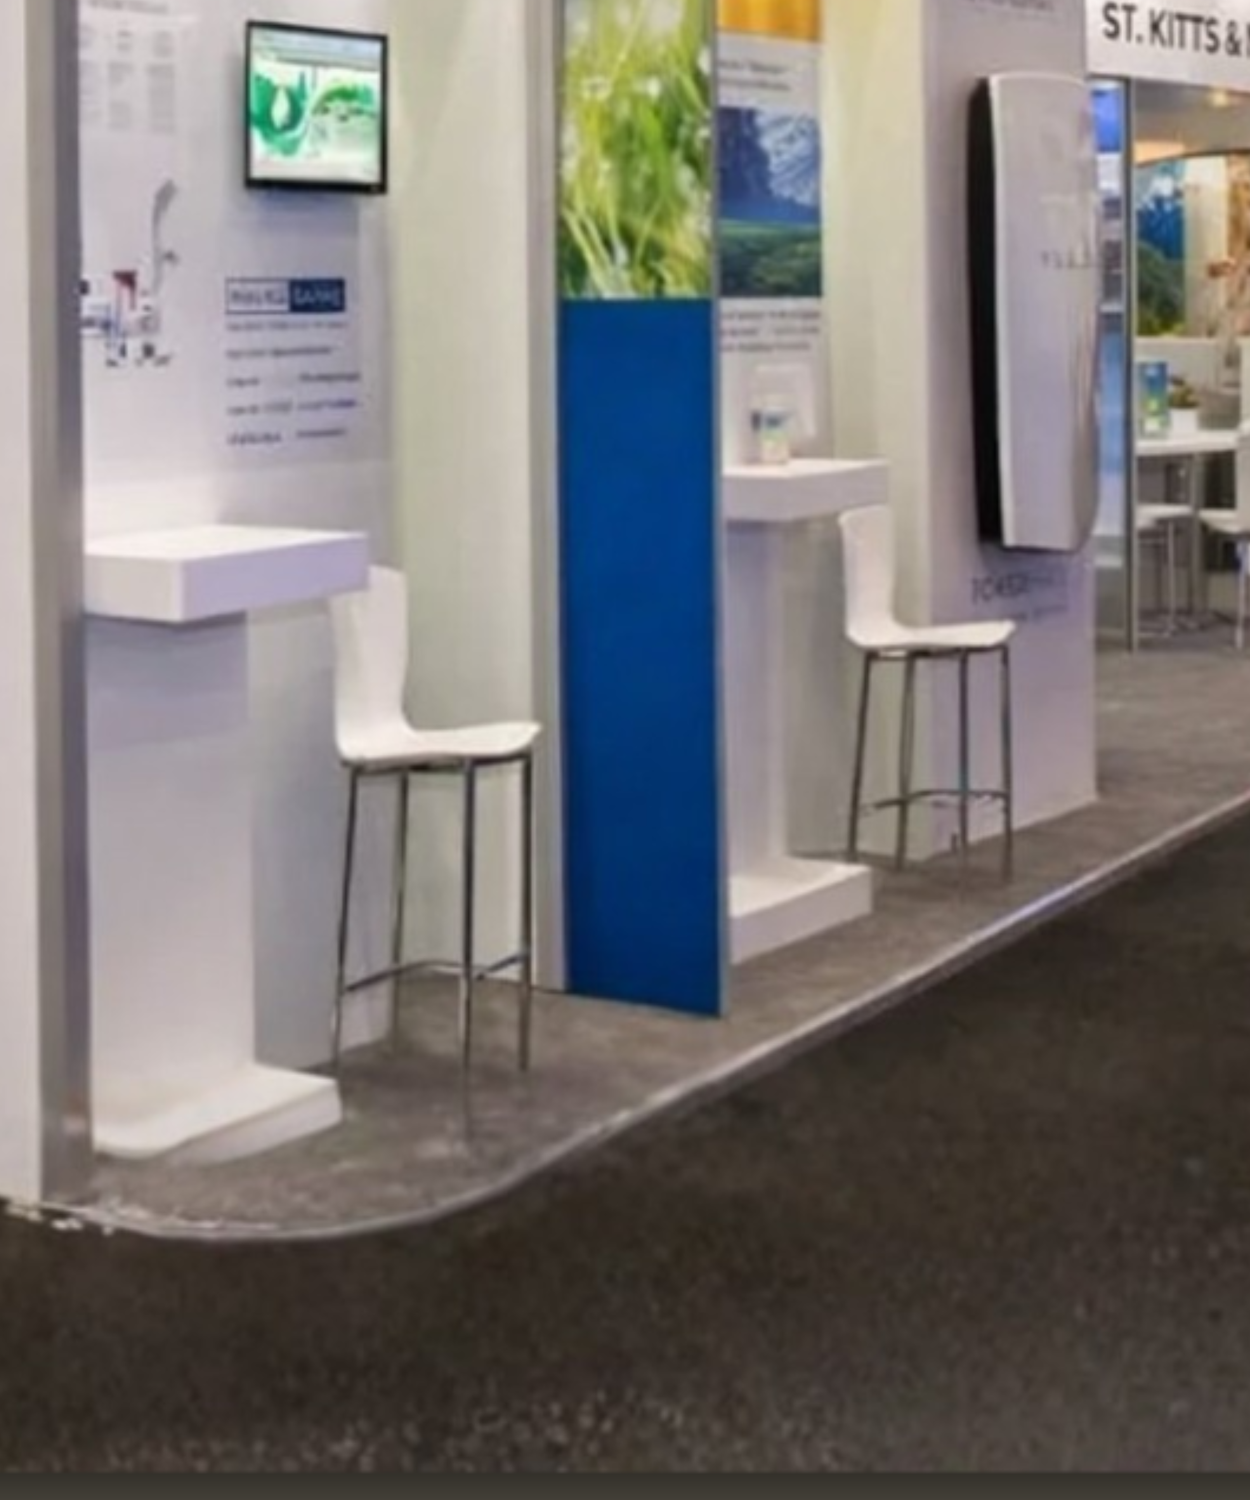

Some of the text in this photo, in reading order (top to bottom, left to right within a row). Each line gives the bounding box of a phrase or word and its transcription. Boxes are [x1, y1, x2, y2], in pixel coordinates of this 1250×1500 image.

[1103, 1, 1143, 43] ST.
[1150, 9, 1220, 55] KITTS
[1225, 19, 1241, 57] &
